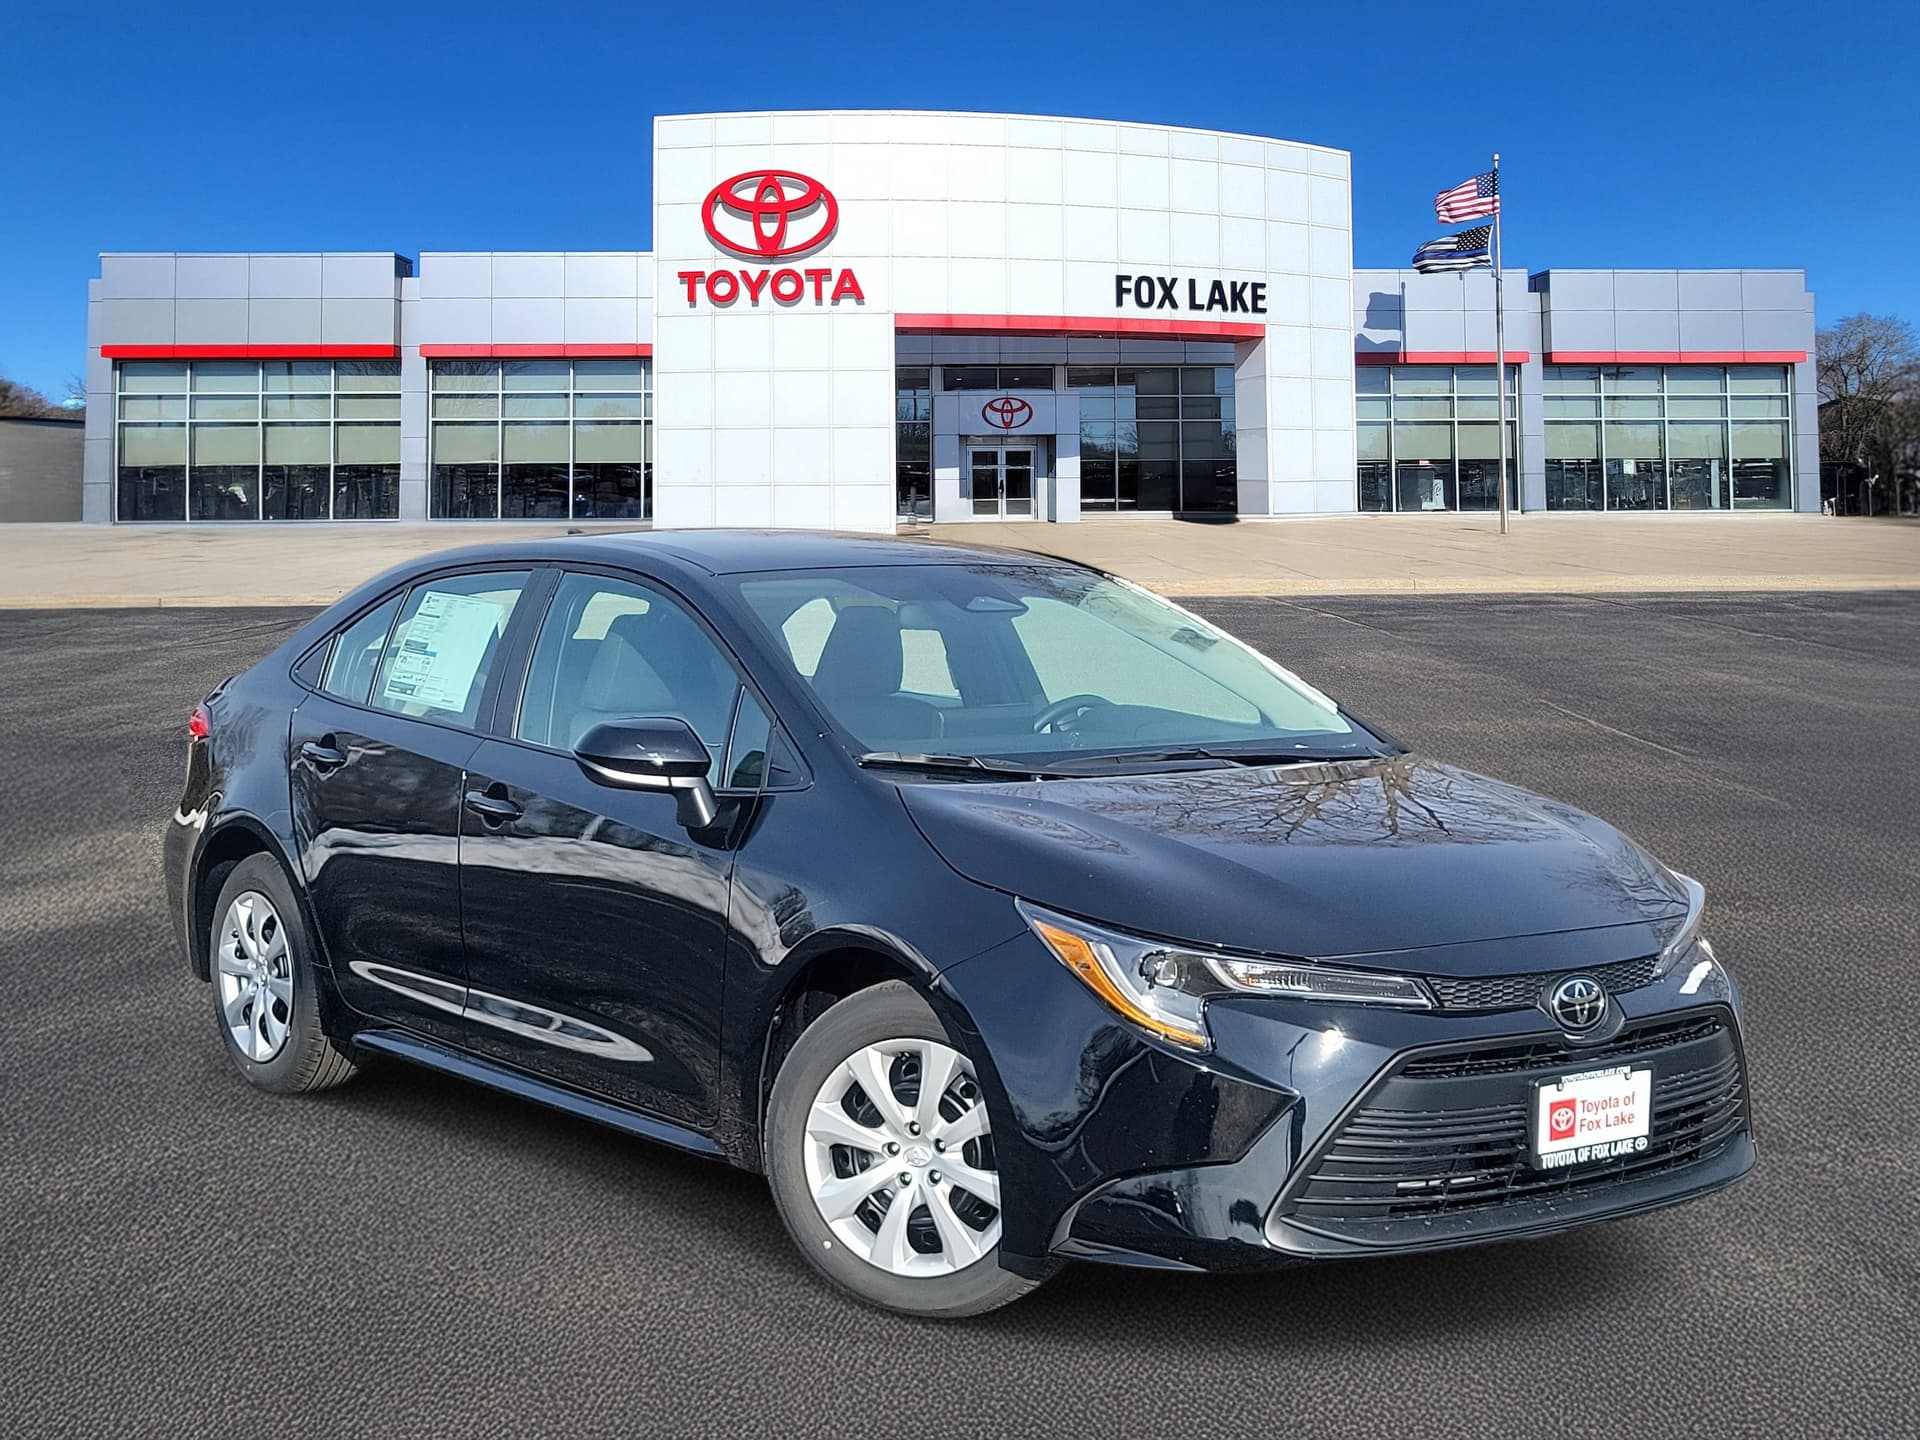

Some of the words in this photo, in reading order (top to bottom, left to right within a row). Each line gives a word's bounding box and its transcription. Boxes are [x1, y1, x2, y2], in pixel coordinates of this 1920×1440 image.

[677, 268, 865, 305] TOYOTA
[1115, 274, 1179, 310] FOX
[1188, 278, 1267, 314] LAKE
[1580, 1095, 1620, 1116] Toyota
[1623, 1091, 1635, 1106] of
[1579, 1117, 1602, 1133] Fox
[1605, 1111, 1635, 1128] Lake
[1541, 1150, 1577, 1169] TOYOTA
[1577, 1146, 1591, 1163] OF
[1591, 1143, 1610, 1160] FOX
[1611, 1139, 1634, 1155] LAKE
